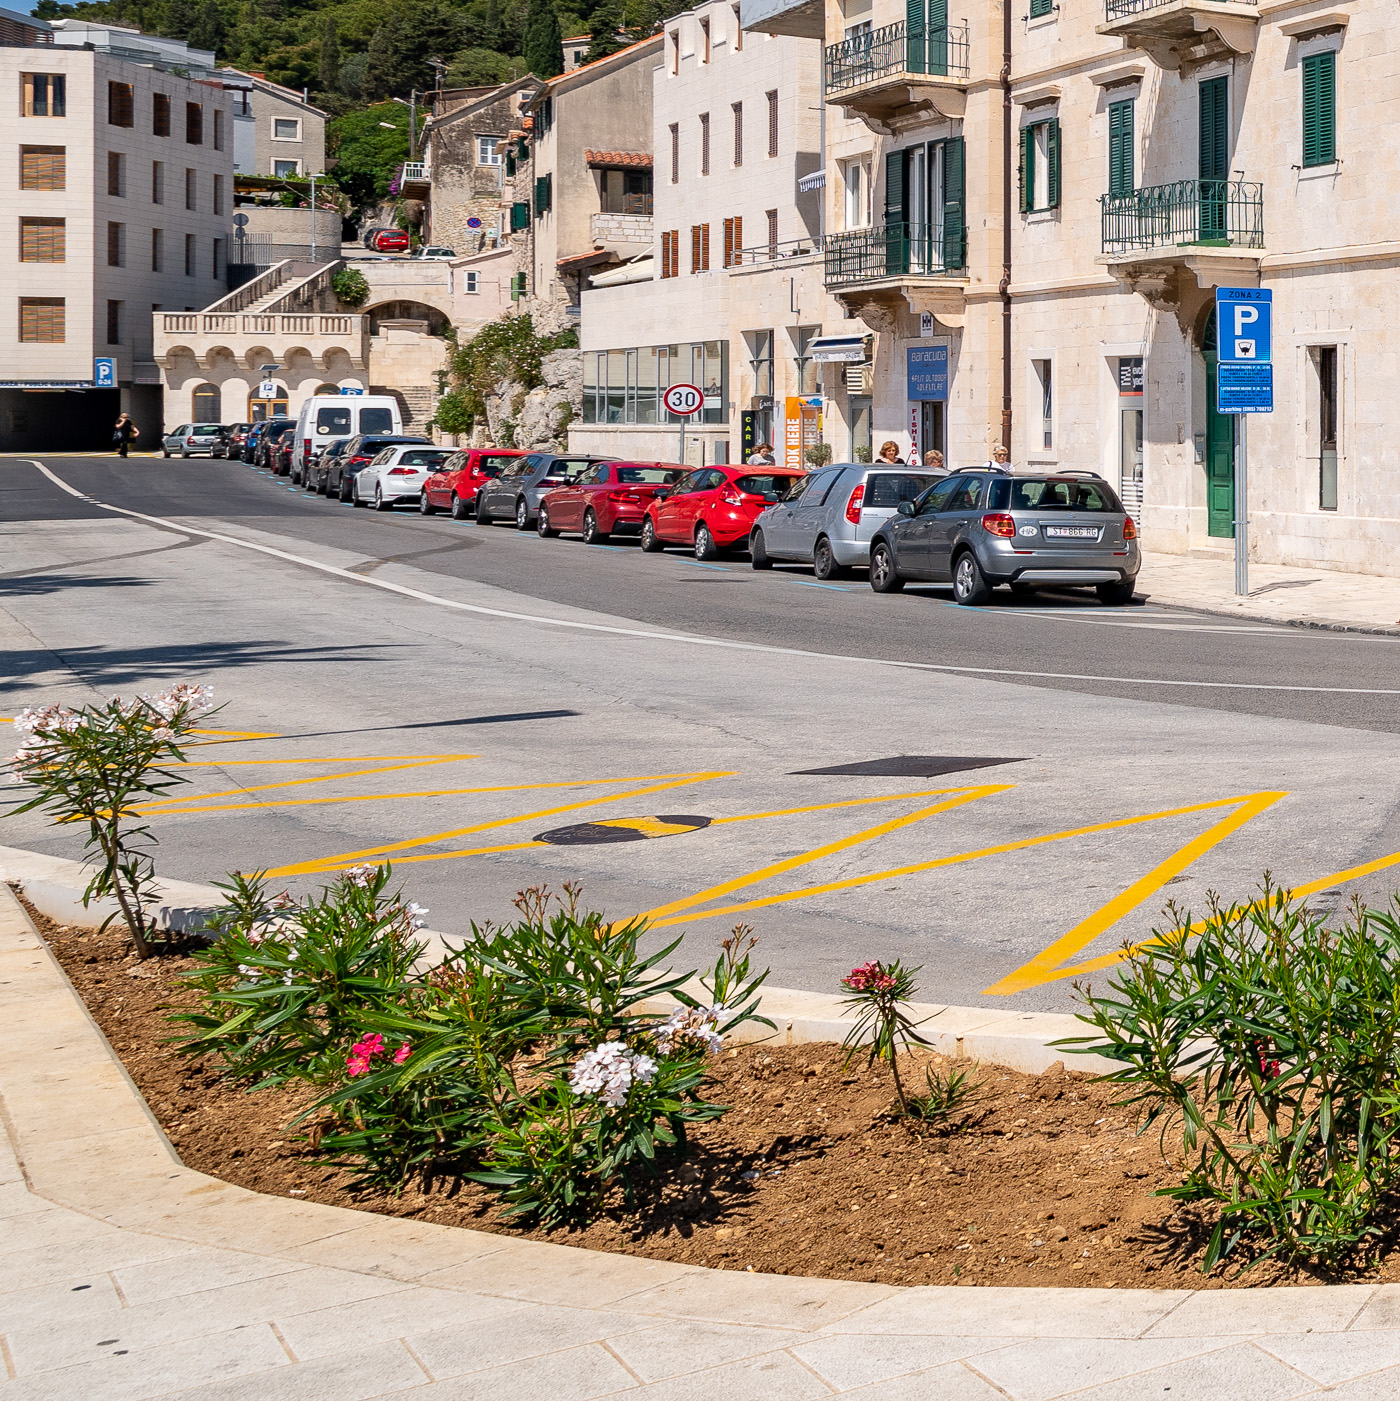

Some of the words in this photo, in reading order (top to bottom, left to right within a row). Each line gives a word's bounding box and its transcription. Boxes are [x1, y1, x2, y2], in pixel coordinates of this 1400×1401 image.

[1229, 290, 1252, 299] ZONA
[1255, 291, 1262, 299] 2
[1234, 305, 1259, 336] P
[100, 365, 110, 379] P
[672, 391, 696, 407] 30
[786, 418, 800, 446] HERE
[786, 448, 800, 469] OOK
